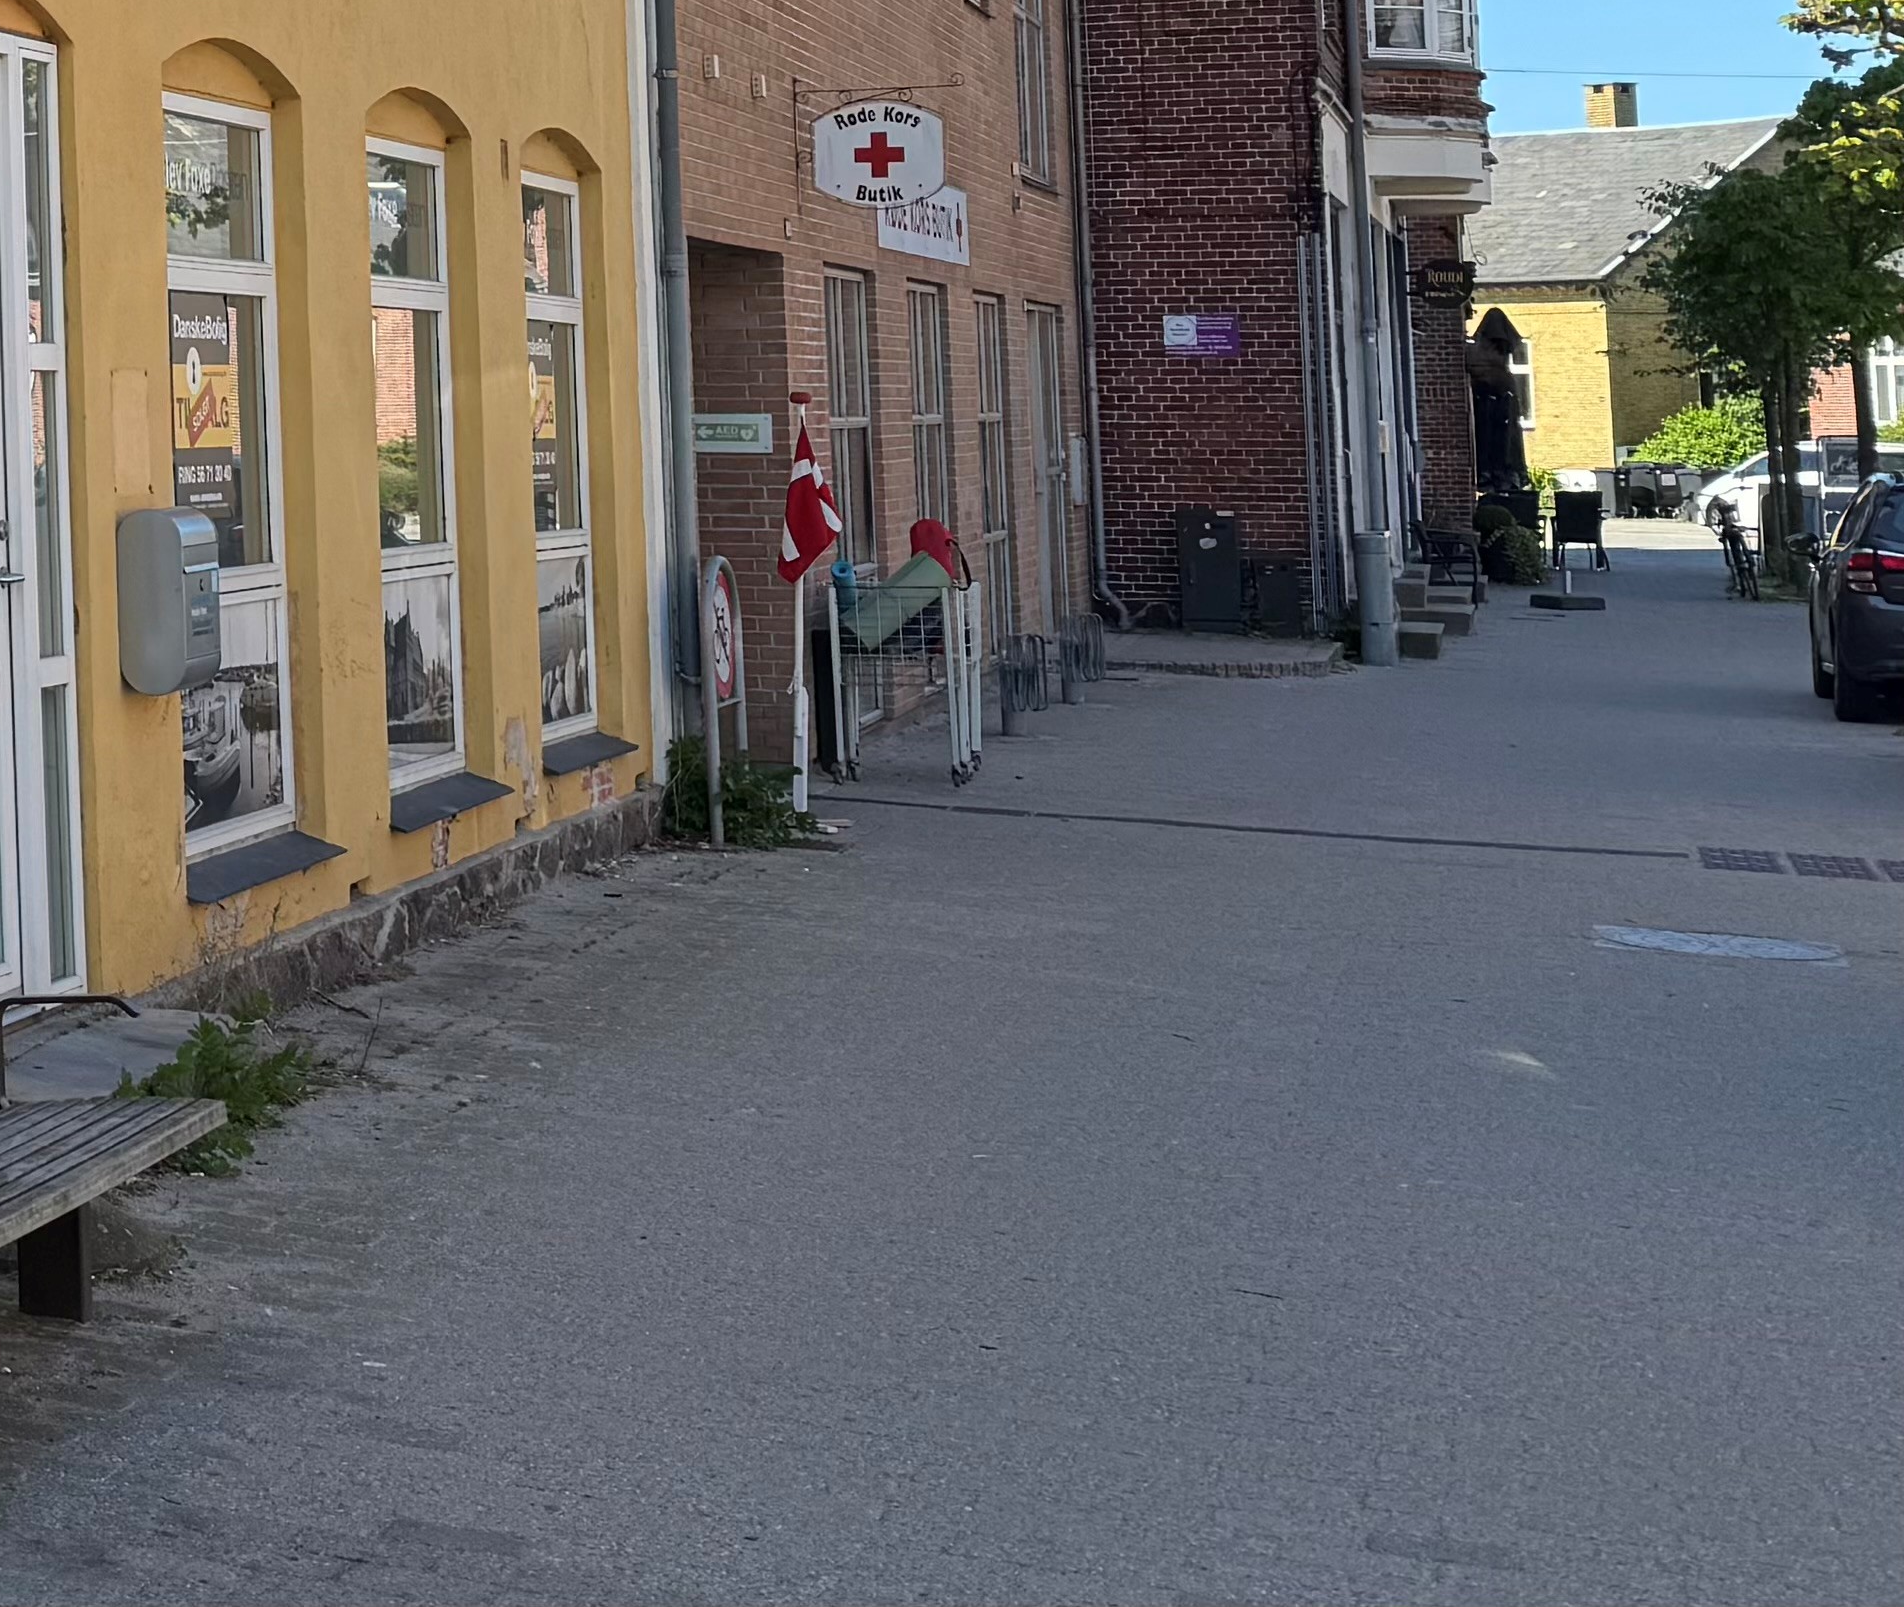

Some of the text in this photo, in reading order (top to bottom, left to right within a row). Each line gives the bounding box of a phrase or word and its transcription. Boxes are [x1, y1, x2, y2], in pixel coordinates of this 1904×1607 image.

[883, 105, 922, 128] Kors
[855, 184, 904, 202] Butik
[173, 313, 228, 346] DanskeBolig
[715, 425, 739, 435] AED
[178, 466, 196, 485] RING
